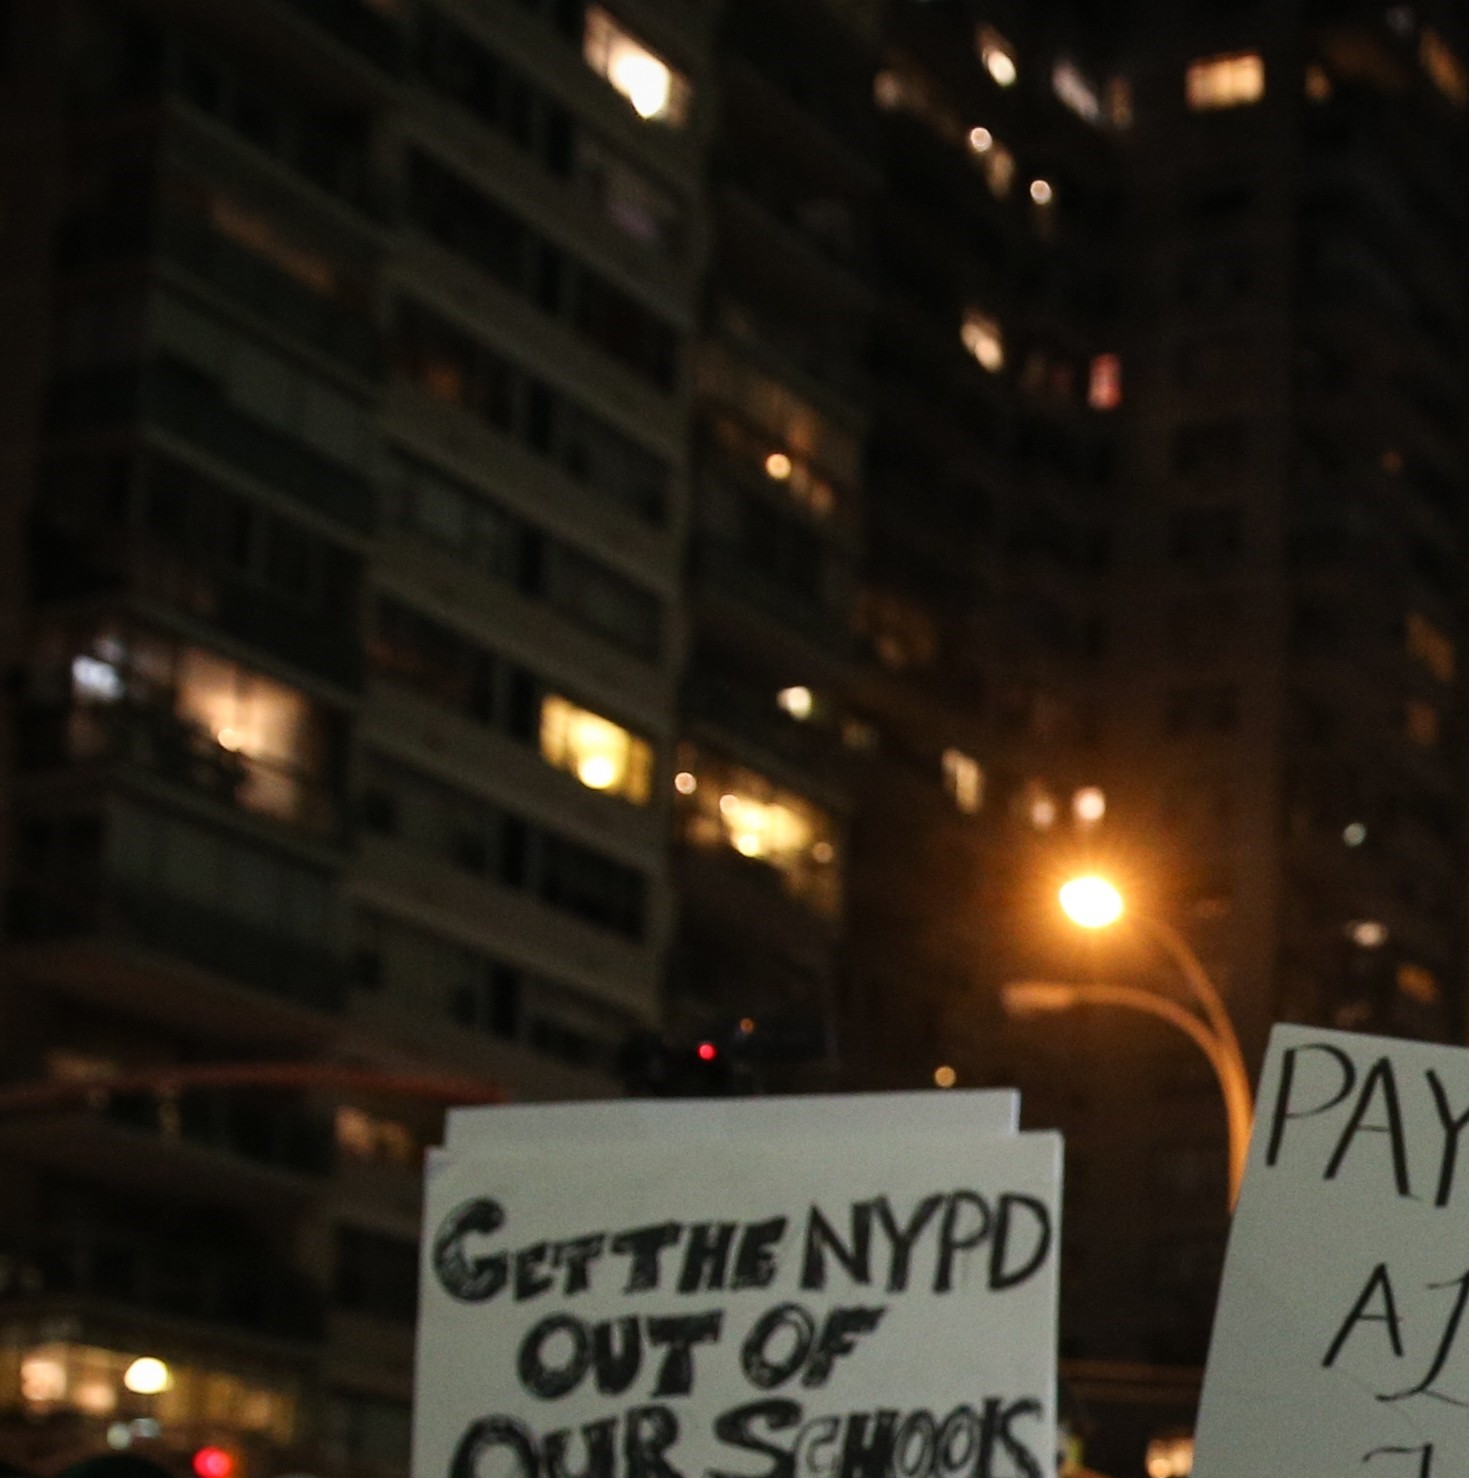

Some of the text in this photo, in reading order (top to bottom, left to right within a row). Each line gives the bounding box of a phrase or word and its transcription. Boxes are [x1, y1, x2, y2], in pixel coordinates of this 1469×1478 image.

[432, 1189, 1051, 1302] GET THE NYPD
[517, 1301, 889, 1401] OUT OF
[1322, 1262, 1404, 1369] A
